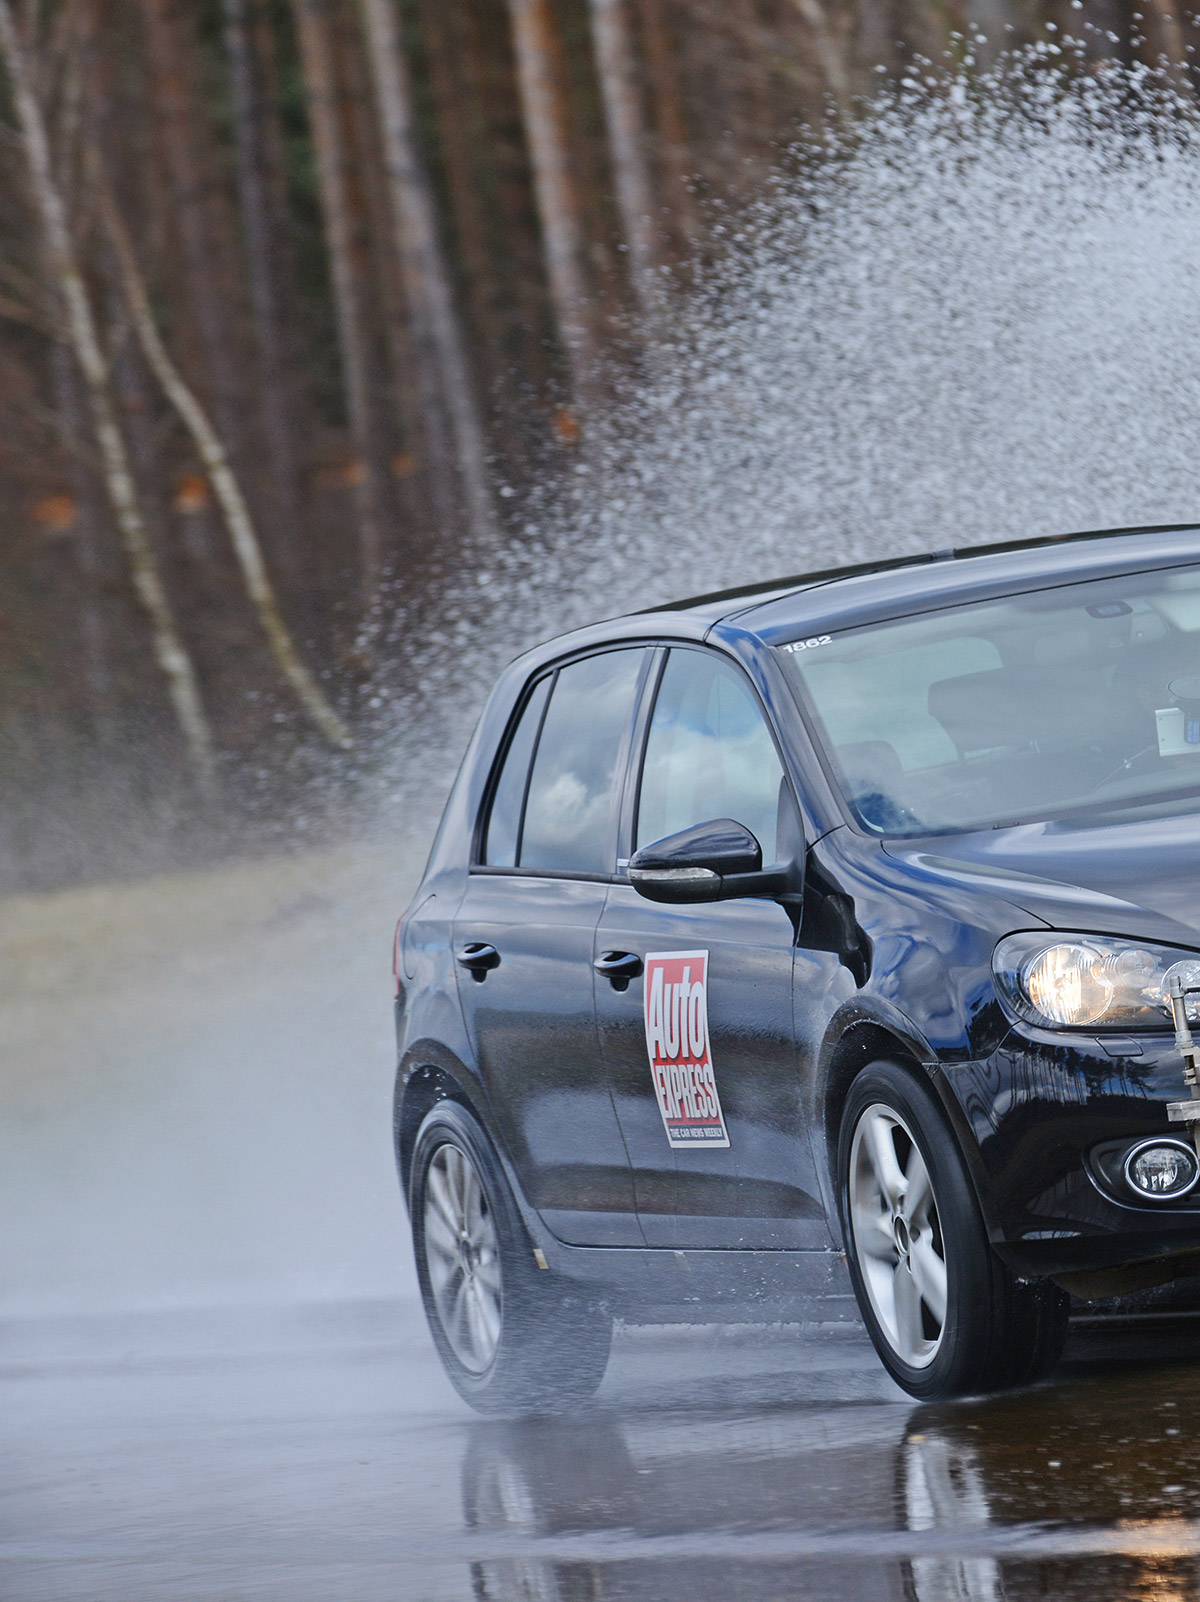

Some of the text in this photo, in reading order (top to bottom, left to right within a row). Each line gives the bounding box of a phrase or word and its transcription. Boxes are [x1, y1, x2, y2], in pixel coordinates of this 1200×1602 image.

[783, 635, 833, 654] 1862
[655, 1063, 719, 1120] EXPRESS
[669, 1127, 723, 1138] THE CAR NEWS WEEKLY
